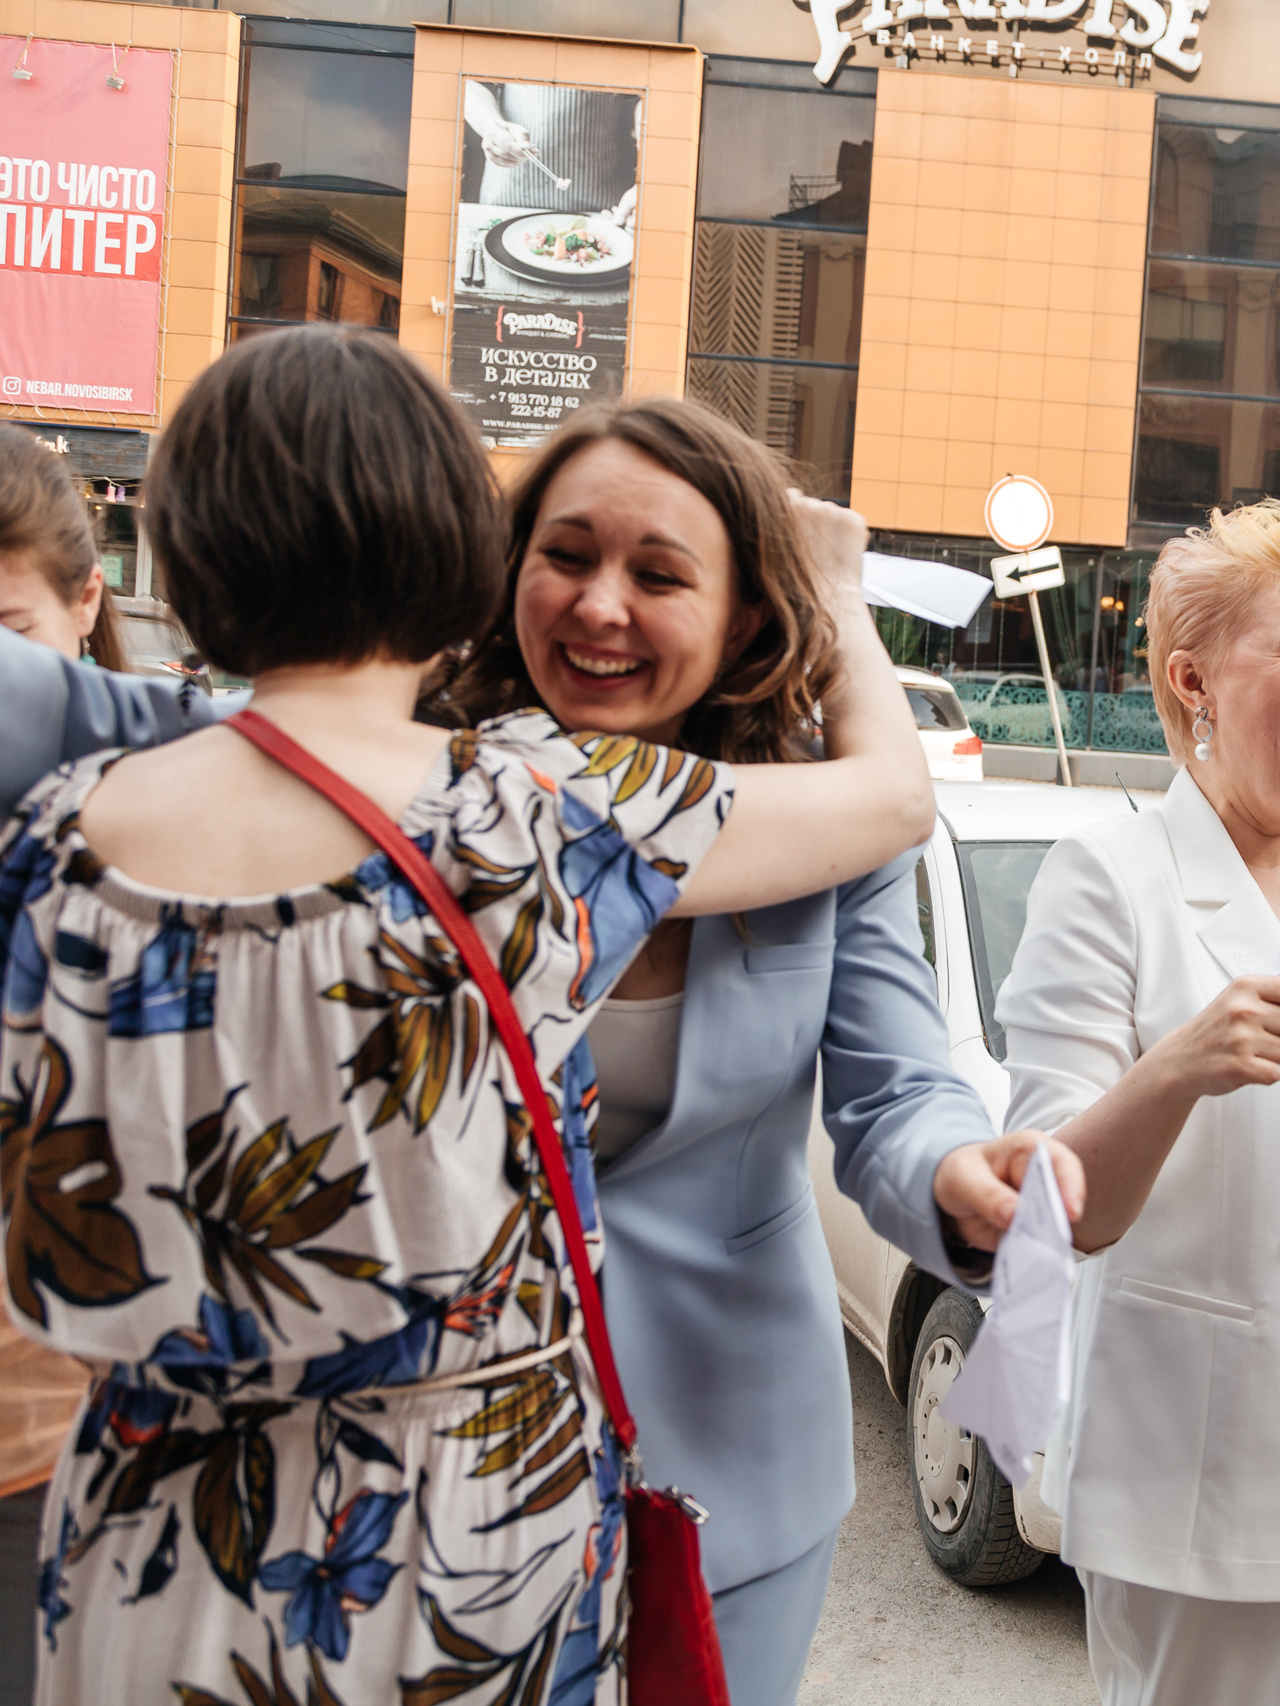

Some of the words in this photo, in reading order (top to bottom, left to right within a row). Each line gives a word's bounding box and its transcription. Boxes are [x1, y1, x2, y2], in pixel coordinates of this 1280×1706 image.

[876, 29, 1025, 59] БАНКЕТ
[0, 156, 50, 203] ЭТО
[57, 162, 156, 212] ЧИСТО
[0, 203, 157, 276] ПИТЕР
[503, 313, 578, 335] PARADISE
[480, 348, 597, 371] ИСКУССТВО
[484, 366, 498, 382] В
[26, 380, 133, 401] NEBAR.NOVOSIBIRSK
[508, 392, 528, 405] 913
[528, 393, 549, 406] 770
[550, 395, 564, 407] 18
[564, 396, 579, 408] 62
[511, 404, 562, 418] 222-15-87
